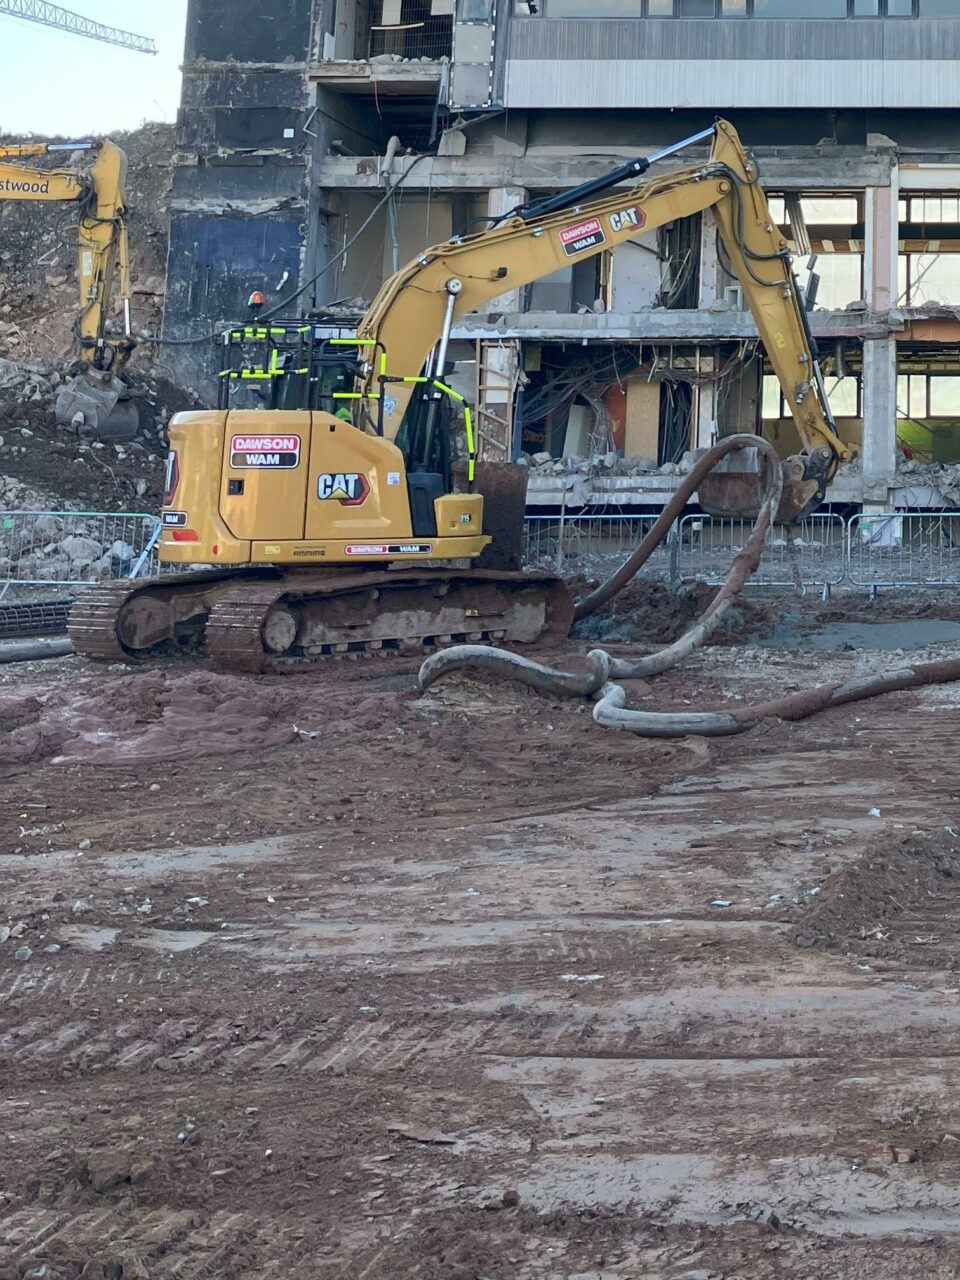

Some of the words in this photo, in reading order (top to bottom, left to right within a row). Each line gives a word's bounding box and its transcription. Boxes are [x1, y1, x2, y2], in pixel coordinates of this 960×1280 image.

[609, 207, 638, 232] CAT
[562, 221, 598, 241] DAWSON
[573, 235, 596, 250] WAM
[235, 438, 295, 450] DAWSON
[246, 453, 280, 465] WAM
[318, 473, 359, 499] CAT
